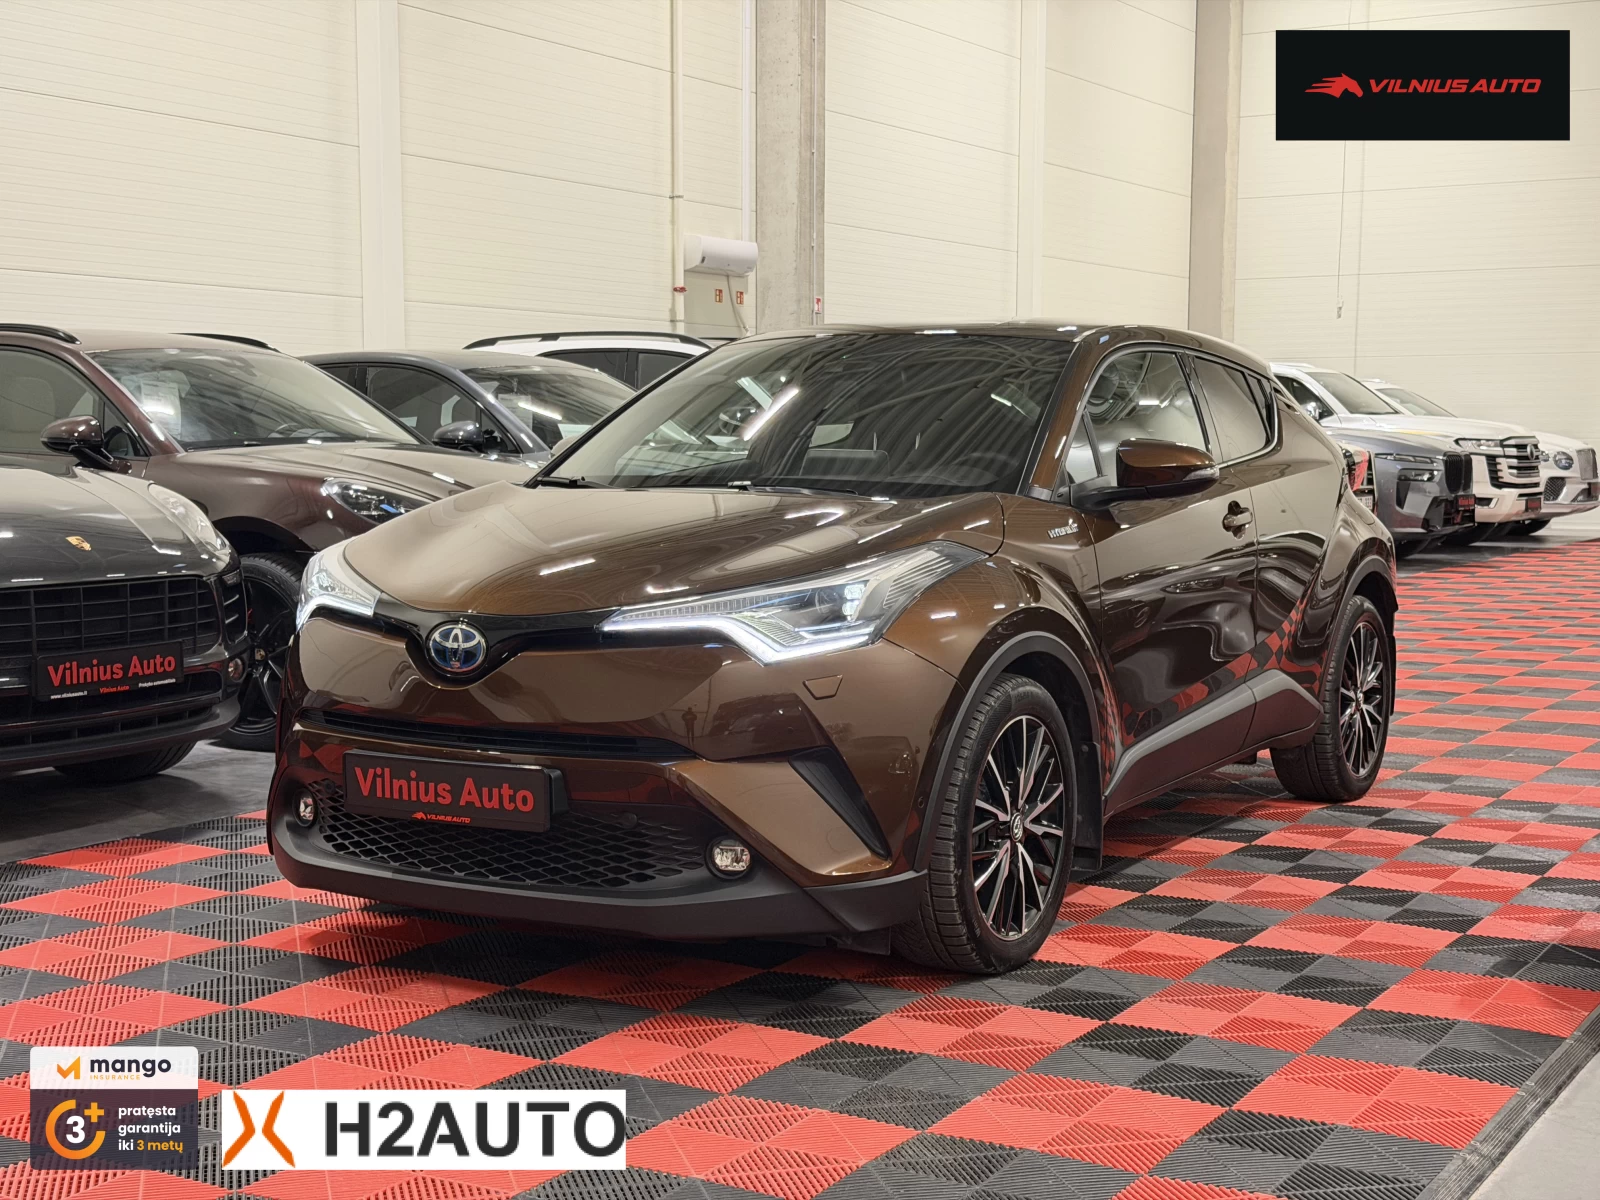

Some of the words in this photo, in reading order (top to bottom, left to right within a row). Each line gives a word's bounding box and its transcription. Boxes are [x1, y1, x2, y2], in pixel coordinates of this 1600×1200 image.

[47, 658, 124, 687] Vilnius
[128, 654, 176, 678] Auto
[354, 767, 452, 805] Vilnius
[459, 777, 534, 813] Auto
[427, 813, 452, 822] VILNIUS
[452, 816, 471, 824] AUTO
